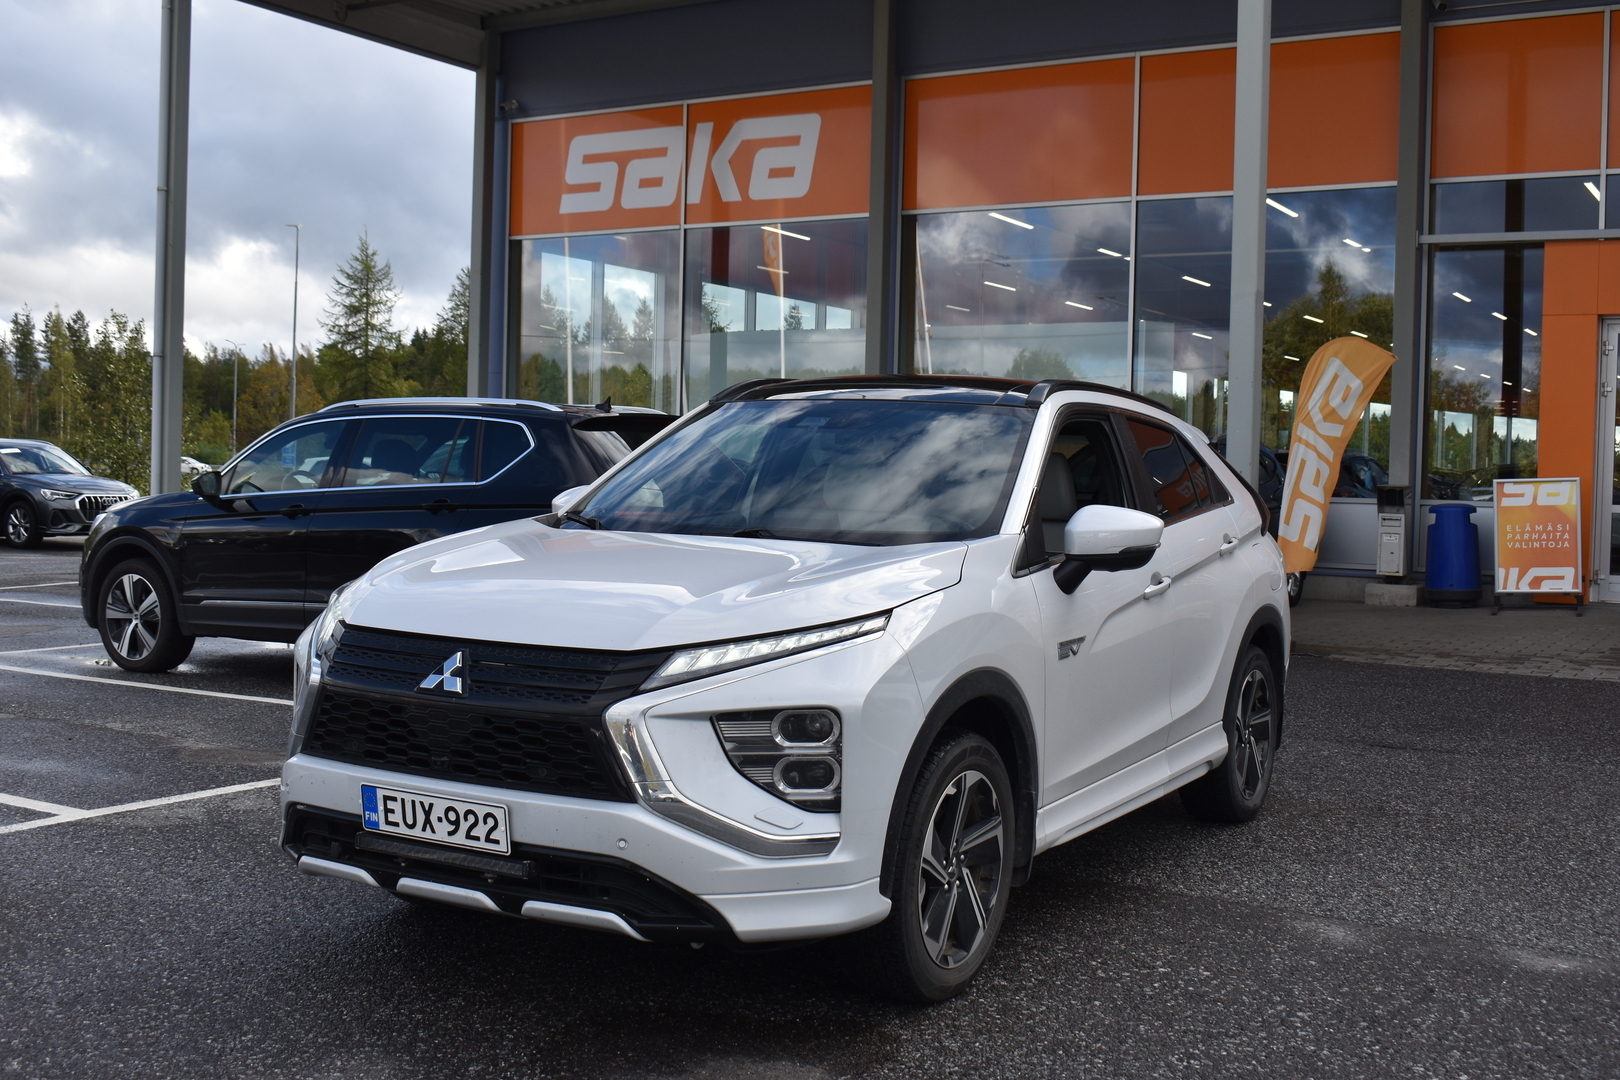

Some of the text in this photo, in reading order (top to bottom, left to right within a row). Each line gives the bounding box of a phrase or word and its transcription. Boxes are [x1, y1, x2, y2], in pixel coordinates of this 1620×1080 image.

[1506, 523, 1570, 532] ELÄMÄSI
[1507, 532, 1570, 540] PARHAITA
[365, 811, 379, 823] FIN
[382, 794, 501, 845] EUX-922
